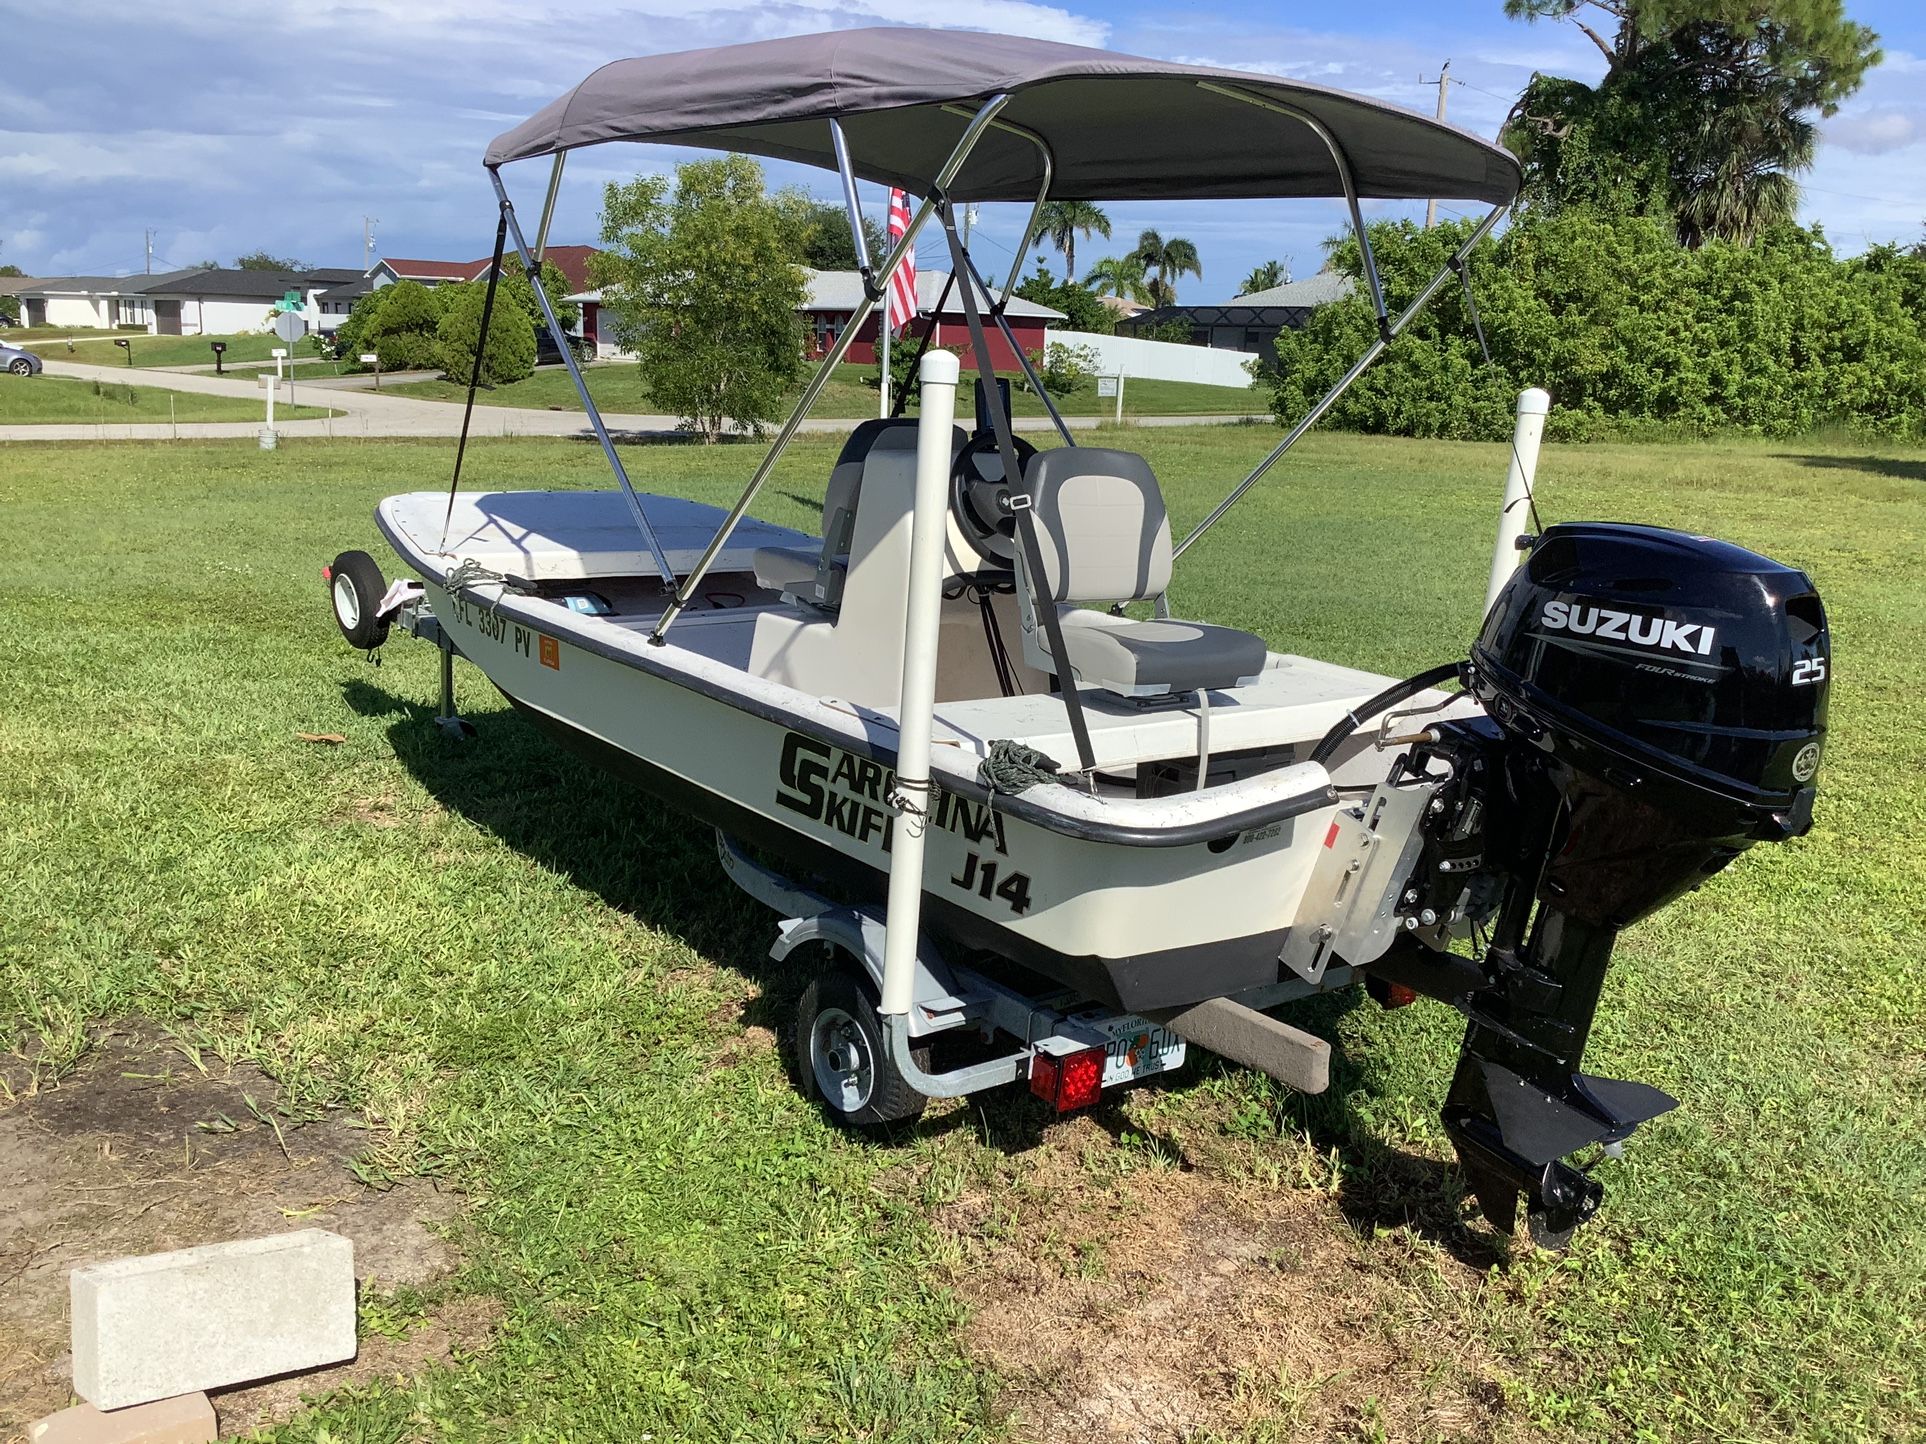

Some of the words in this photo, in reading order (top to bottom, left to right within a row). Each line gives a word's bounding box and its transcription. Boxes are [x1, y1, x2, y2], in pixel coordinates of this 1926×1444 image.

[459, 599, 472, 628] FL
[478, 607, 507, 645] 3307
[515, 625, 531, 658] PV
[1541, 600, 1715, 655] SUZUKI
[1791, 656, 1825, 686] 25
[778, 731, 1009, 857] CARINA
[950, 851, 1032, 915] J14
